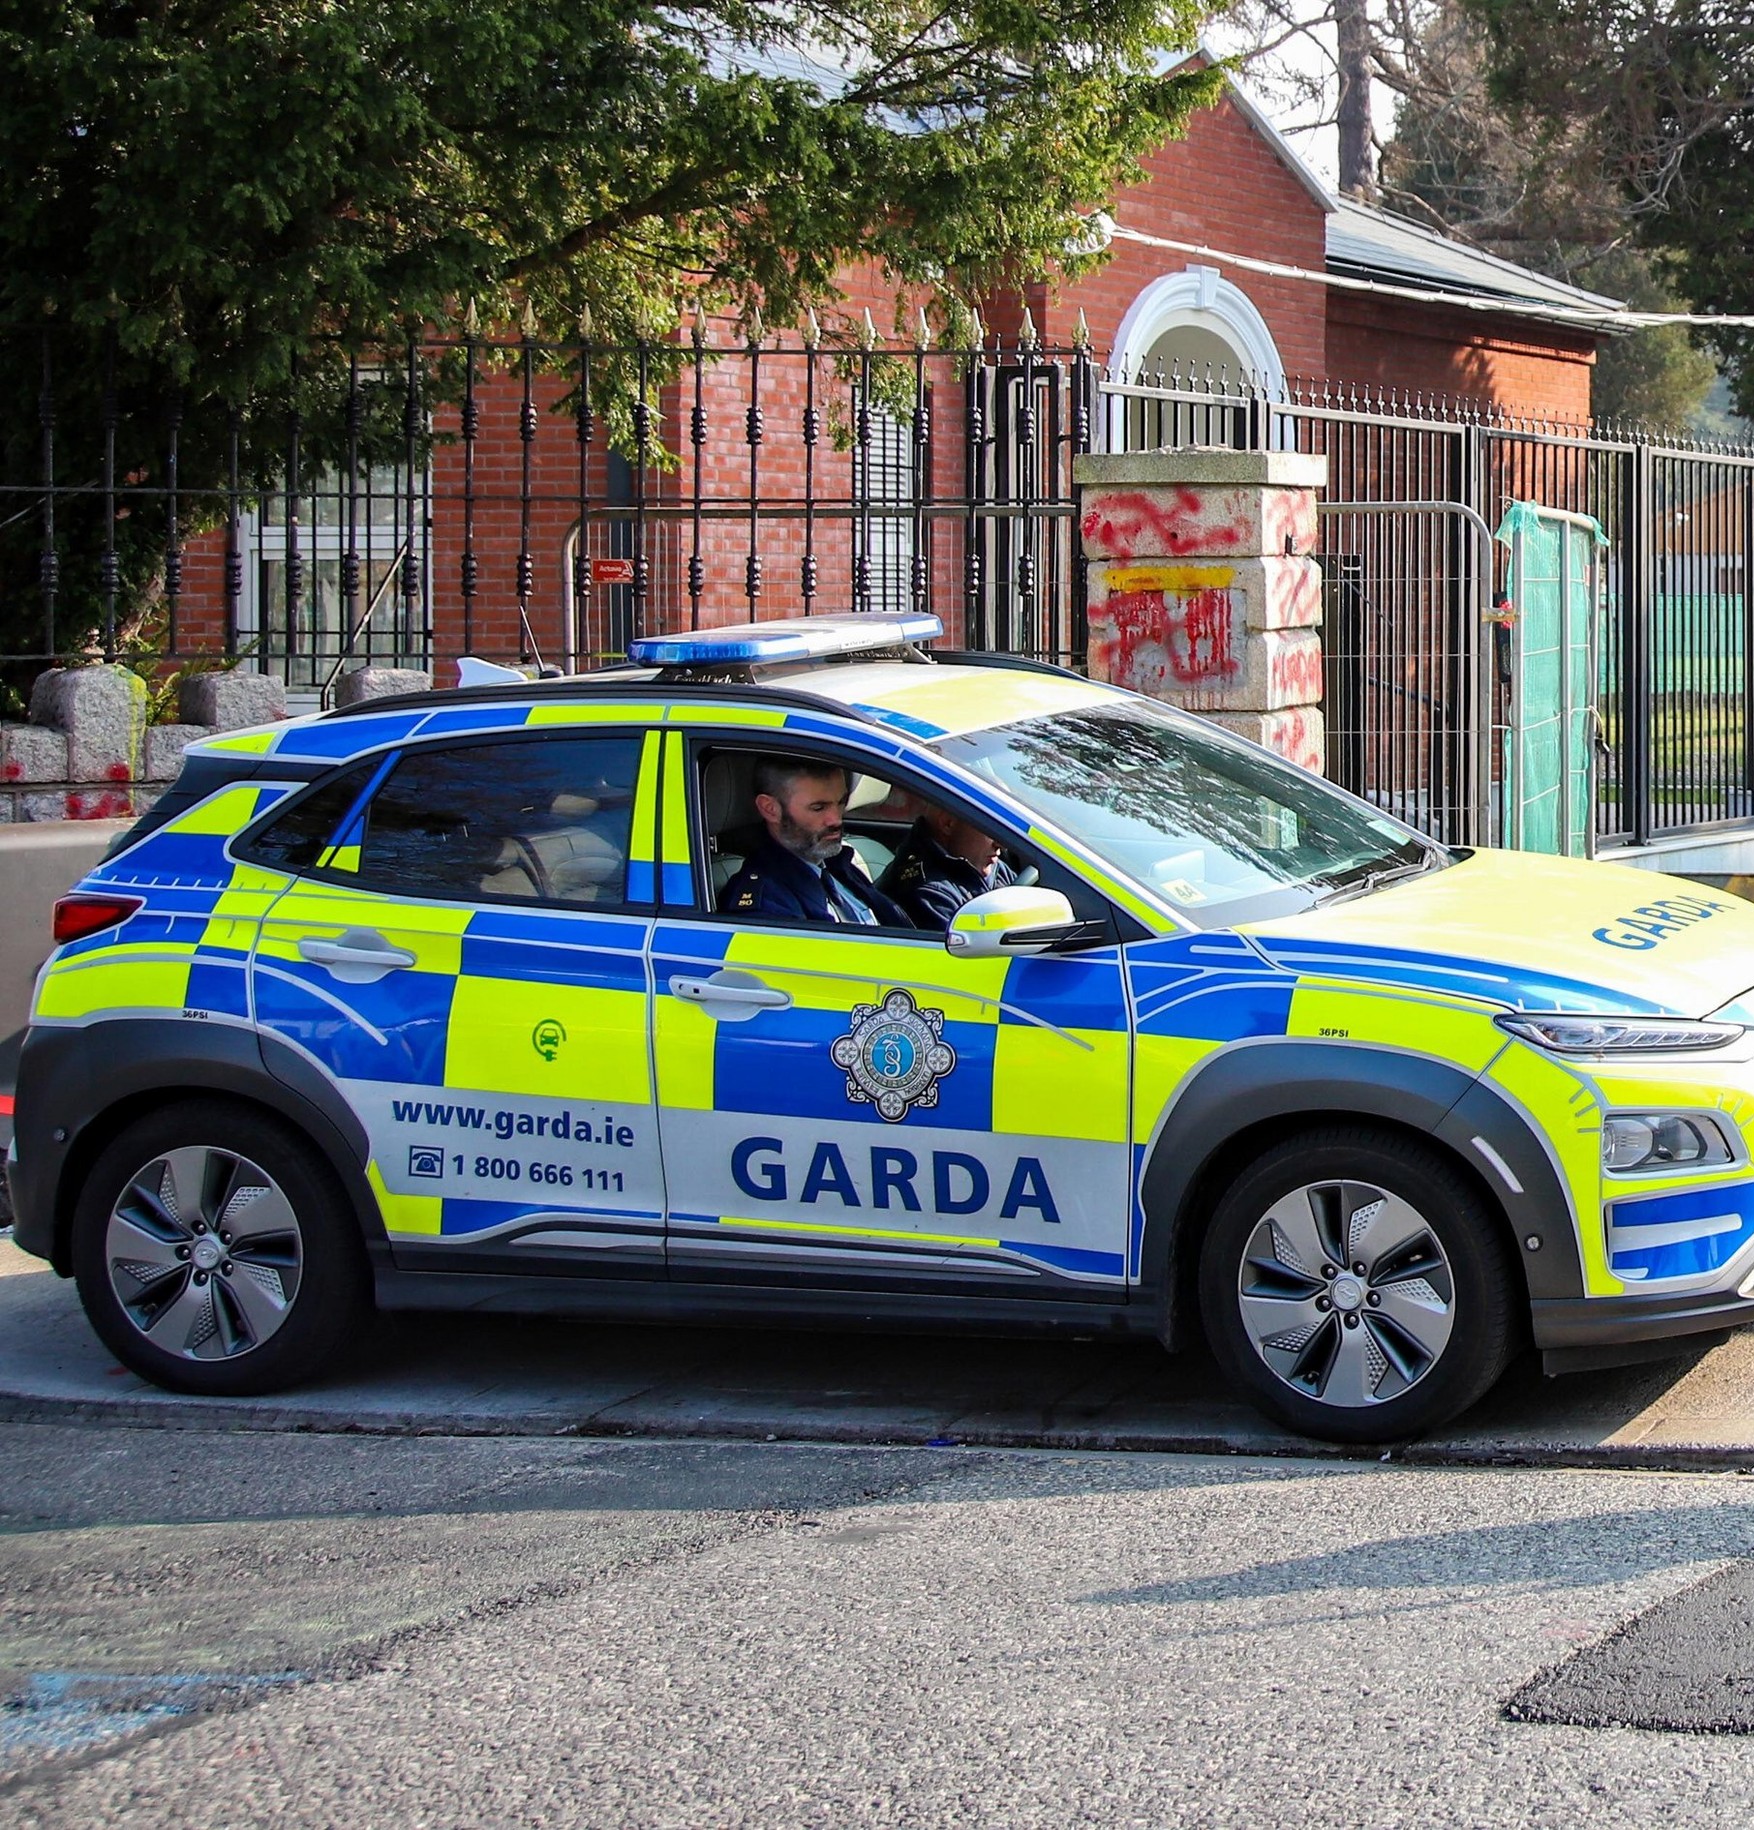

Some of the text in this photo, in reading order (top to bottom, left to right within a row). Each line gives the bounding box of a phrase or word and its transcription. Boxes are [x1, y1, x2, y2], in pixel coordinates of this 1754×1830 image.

[1591, 895, 1737, 950] GARDA
[1318, 1028, 1349, 1038] 36PSI
[392, 1100, 635, 1148] www.garda.ie
[451, 1154, 624, 1193] 1 800 666 111
[730, 1136, 1061, 1224] GARDA
